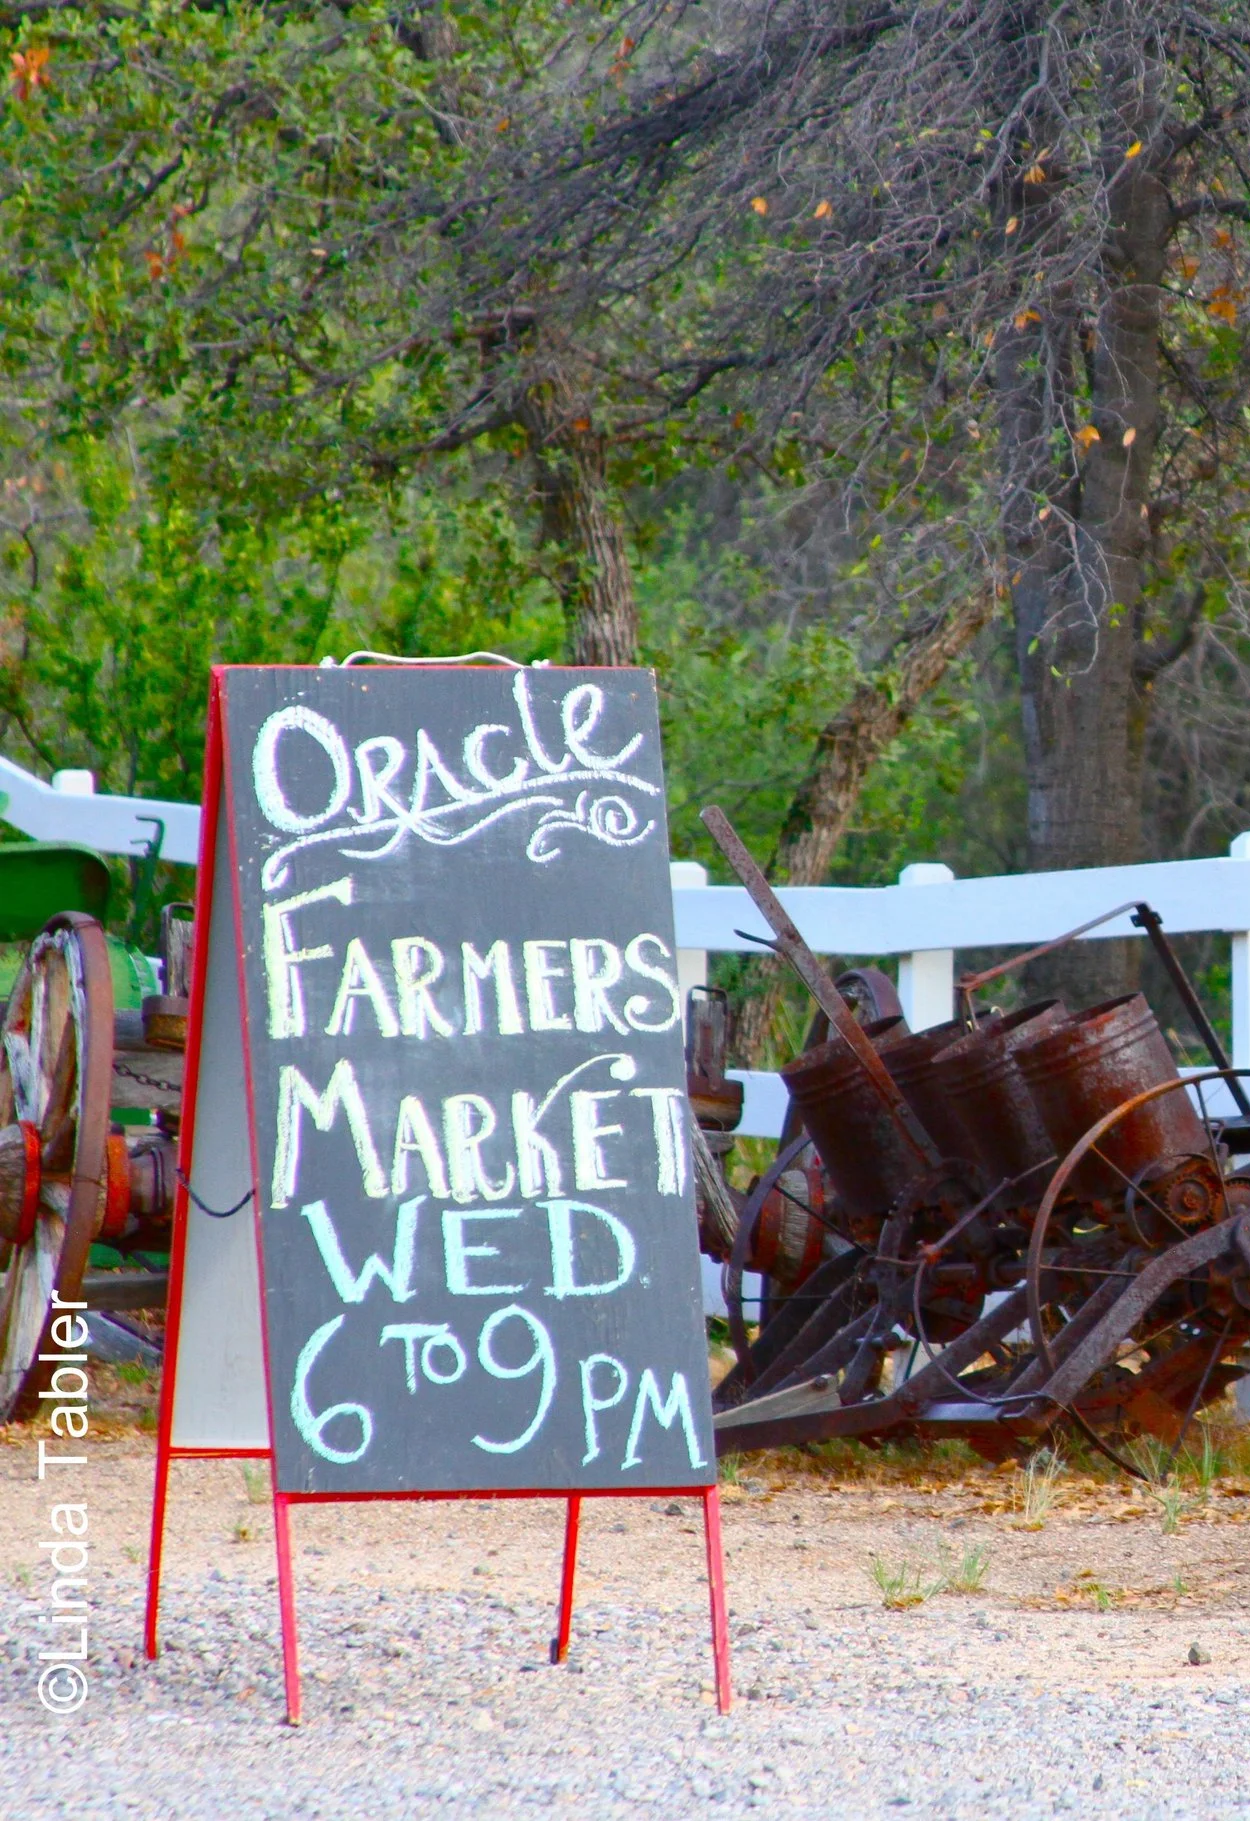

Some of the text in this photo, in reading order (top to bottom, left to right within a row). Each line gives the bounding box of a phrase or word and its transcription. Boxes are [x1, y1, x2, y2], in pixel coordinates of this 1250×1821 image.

[262, 876, 681, 1039] FARMERS
[270, 1054, 687, 1208] MARKET
[301, 1195, 636, 1303] WED
[290, 1303, 708, 1470] 6 TO 9 PM
